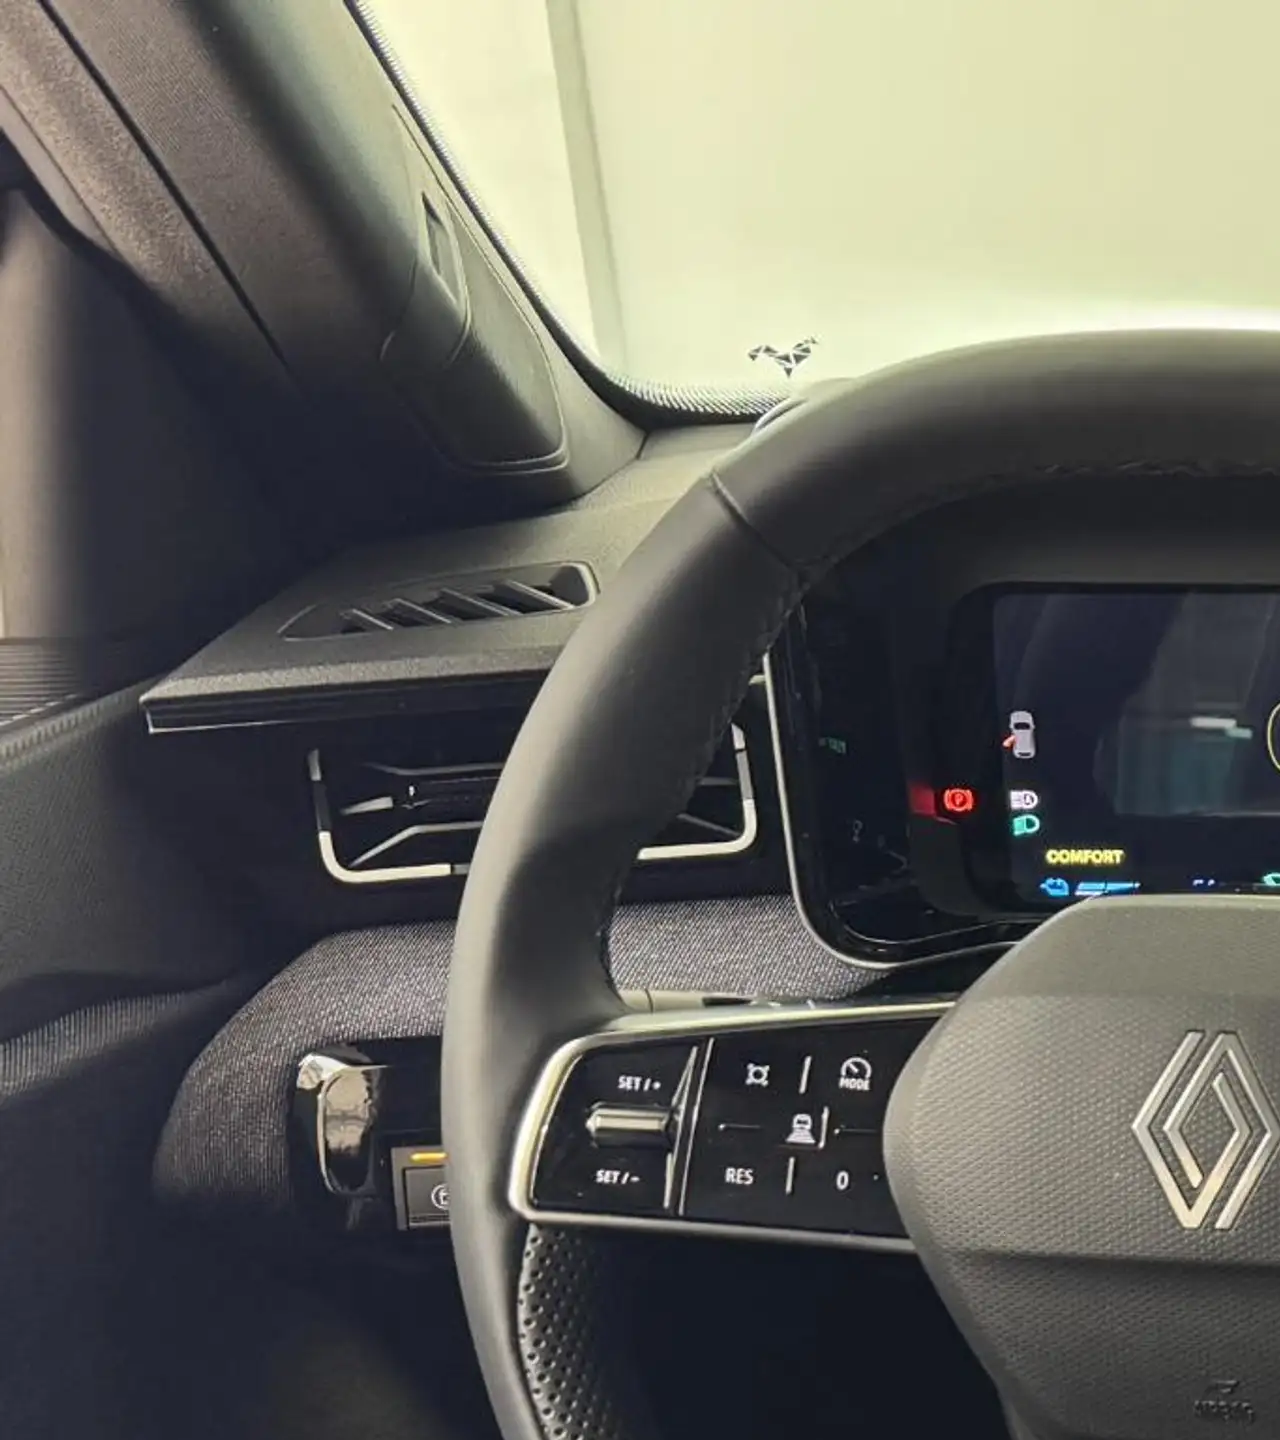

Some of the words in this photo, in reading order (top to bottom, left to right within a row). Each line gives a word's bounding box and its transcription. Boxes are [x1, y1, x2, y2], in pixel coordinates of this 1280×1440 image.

[1045, 848, 1125, 866] COMFORT
[838, 1077, 871, 1091] MODE
[725, 1167, 754, 1185] RES
